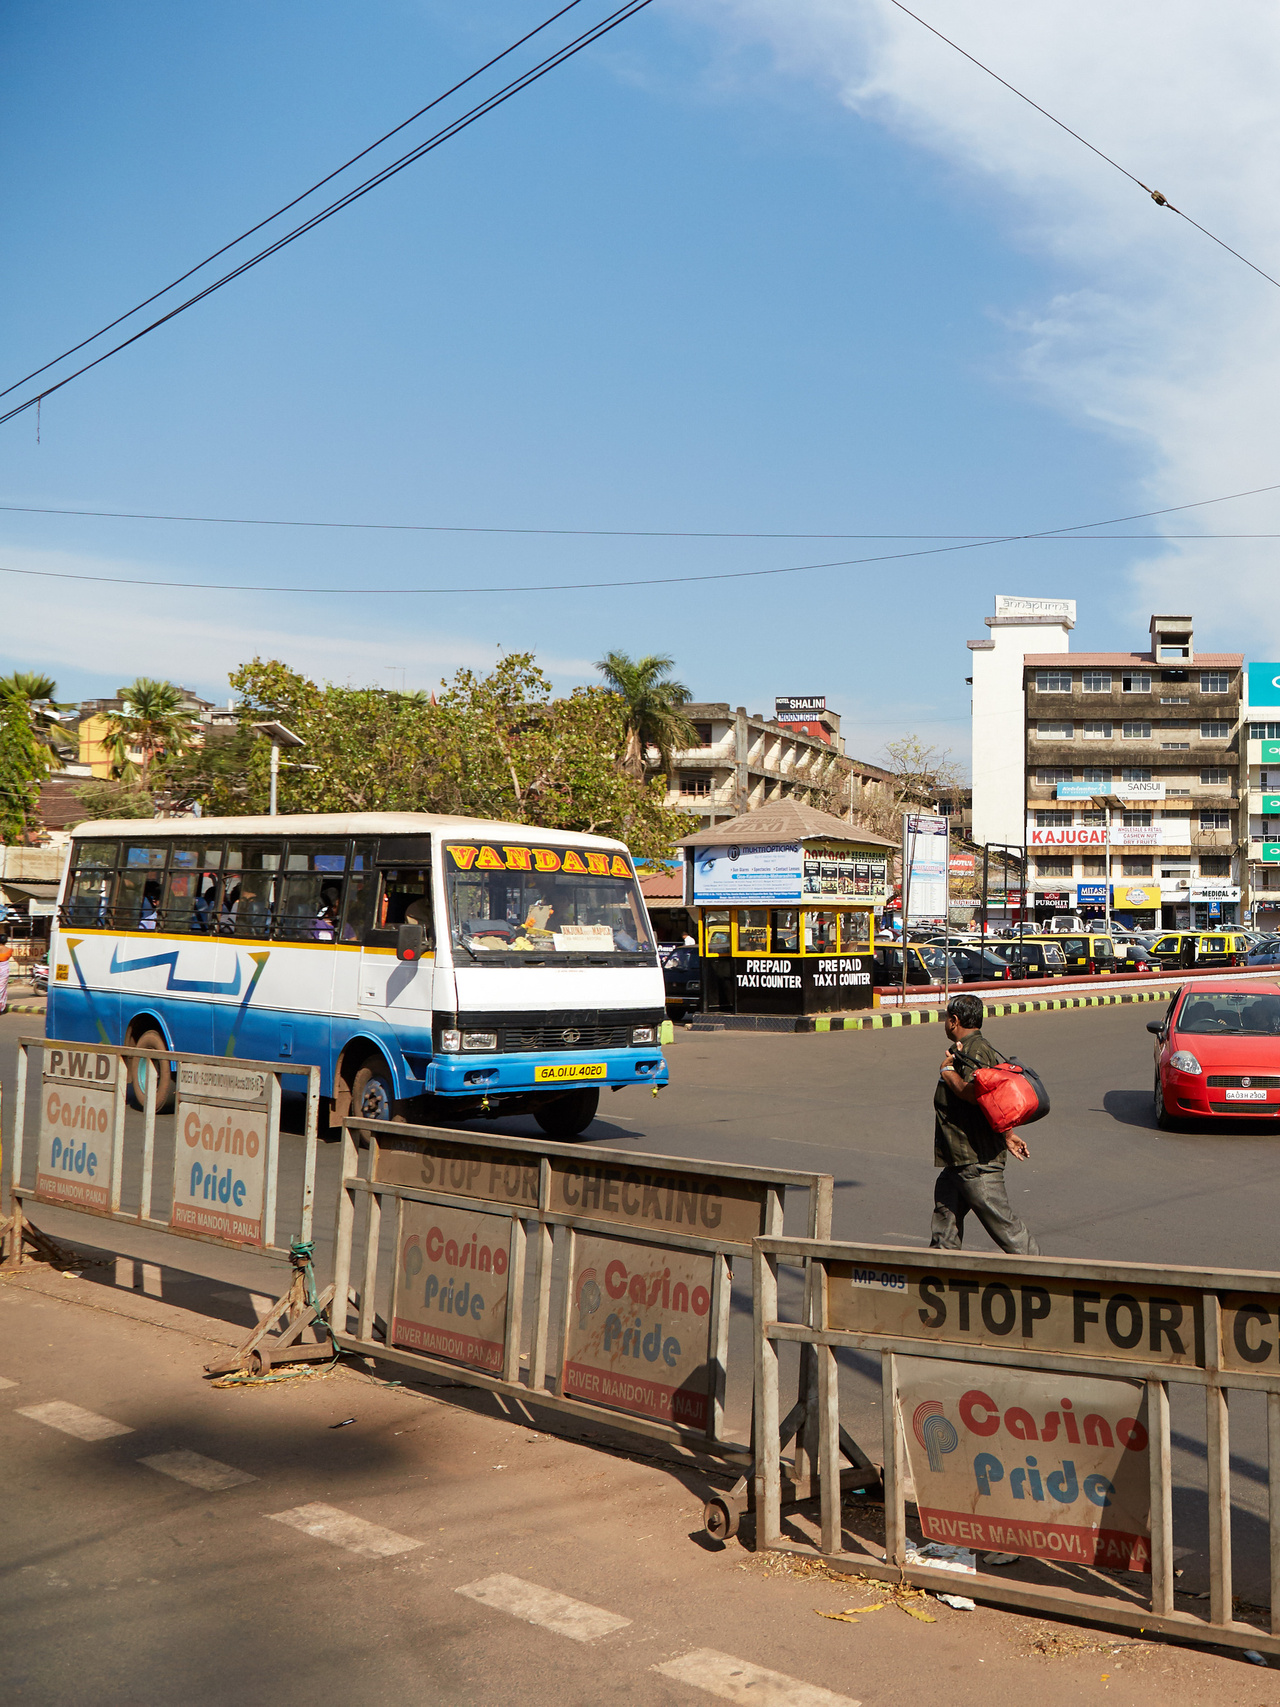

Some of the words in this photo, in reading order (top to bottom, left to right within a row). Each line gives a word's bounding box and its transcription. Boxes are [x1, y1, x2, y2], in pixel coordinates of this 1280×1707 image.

[779, 713, 818, 721] MOONLIGHT
[790, 699, 825, 709] SHALINI
[1127, 783, 1160, 791] SANSUI
[733, 823, 782, 832] TAXI
[447, 846, 633, 879] VANDANA
[736, 975, 760, 987] TAXI
[761, 975, 802, 988] COUNTER
[746, 960, 792, 973] PREPAID
[813, 974, 837, 986] TAXI
[840, 973, 871, 986] COUNTER
[50, 1050, 111, 1080] P.W.D
[47, 1092, 108, 1133] Casino
[184, 1112, 259, 1158] Casino
[51, 1136, 98, 1177] Pride
[39, 1178, 56, 1193] RIVER
[57, 1182, 85, 1202] MANDOVI,
[85, 1189, 107, 1206] PANAJI
[190, 1162, 247, 1207] Pride
[421, 1147, 481, 1190] STOP
[489, 1155, 538, 1201] FOR
[562, 1164, 722, 1229] CHECKING
[176, 1208, 197, 1226] RIVER
[197, 1213, 231, 1234] MANDOVI,
[233, 1221, 260, 1240] PANAJI
[426, 1226, 508, 1275] Casino
[424, 1274, 485, 1321] Pride
[604, 1259, 710, 1317] Casino
[853, 1267, 906, 1290] MP-005
[918, 1275, 1052, 1338] STOP
[1072, 1290, 1187, 1355] FOR
[395, 1325, 421, 1346] RIVER
[423, 1331, 466, 1360] MANDOVI,
[467, 1341, 502, 1368] PANAJI
[603, 1313, 682, 1367] Pride
[568, 1370, 600, 1394] RIVER
[602, 1377, 658, 1410] MANDOVI,
[660, 1392, 704, 1420] PANAJI
[959, 1389, 1149, 1453] Casino
[973, 1452, 1116, 1507] Pride
[928, 1515, 984, 1543] RIVER
[989, 1524, 1087, 1558] MANDOVI,
[1092, 1535, 1149, 1565] PANA
